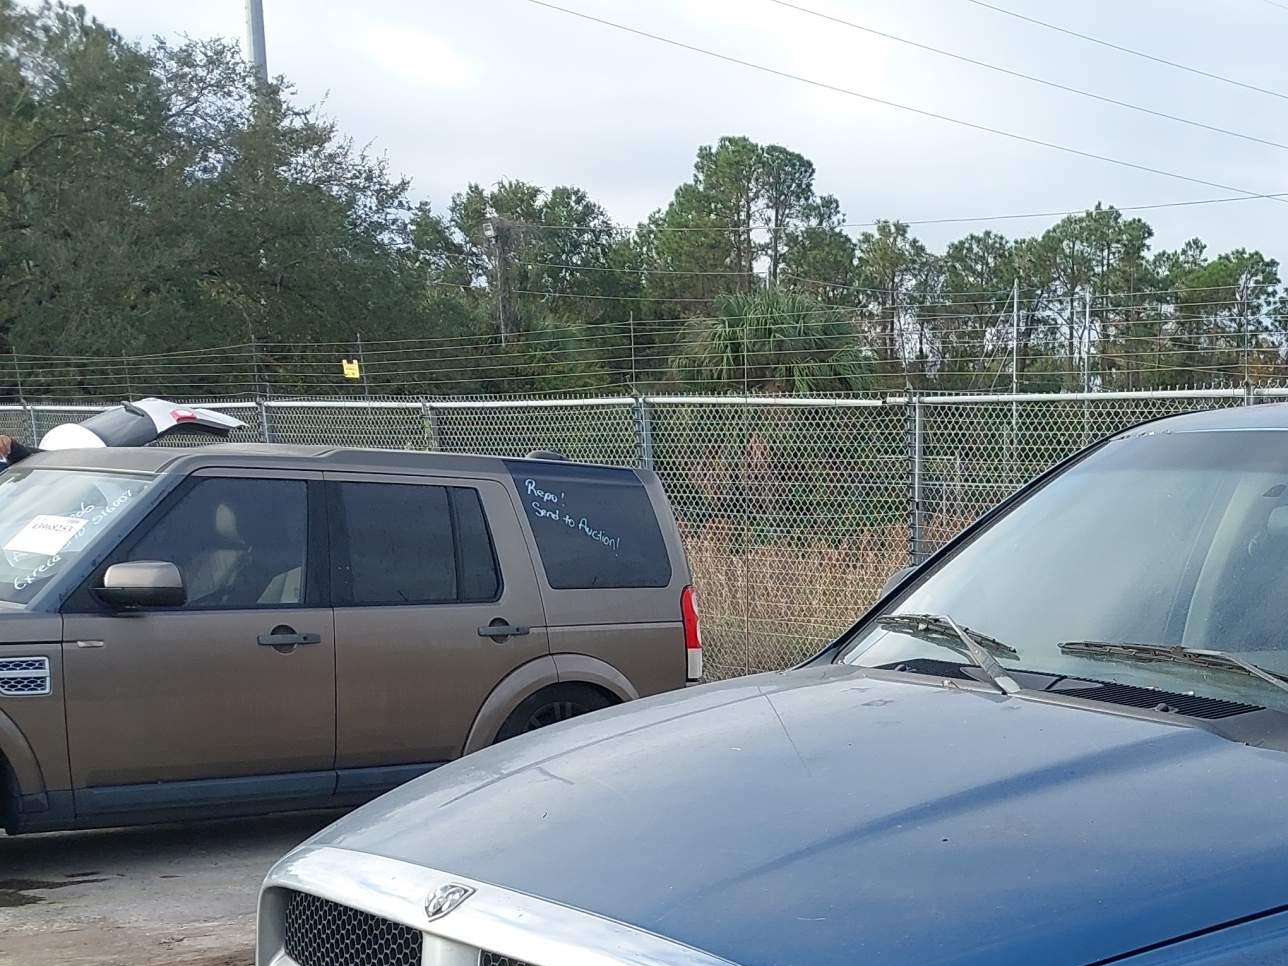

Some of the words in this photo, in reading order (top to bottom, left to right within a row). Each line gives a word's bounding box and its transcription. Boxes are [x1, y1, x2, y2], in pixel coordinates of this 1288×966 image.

[525, 479, 565, 507] Repo!
[532, 501, 560, 521] Send
[563, 515, 575, 528] to
[578, 518, 620, 557] Auction!
